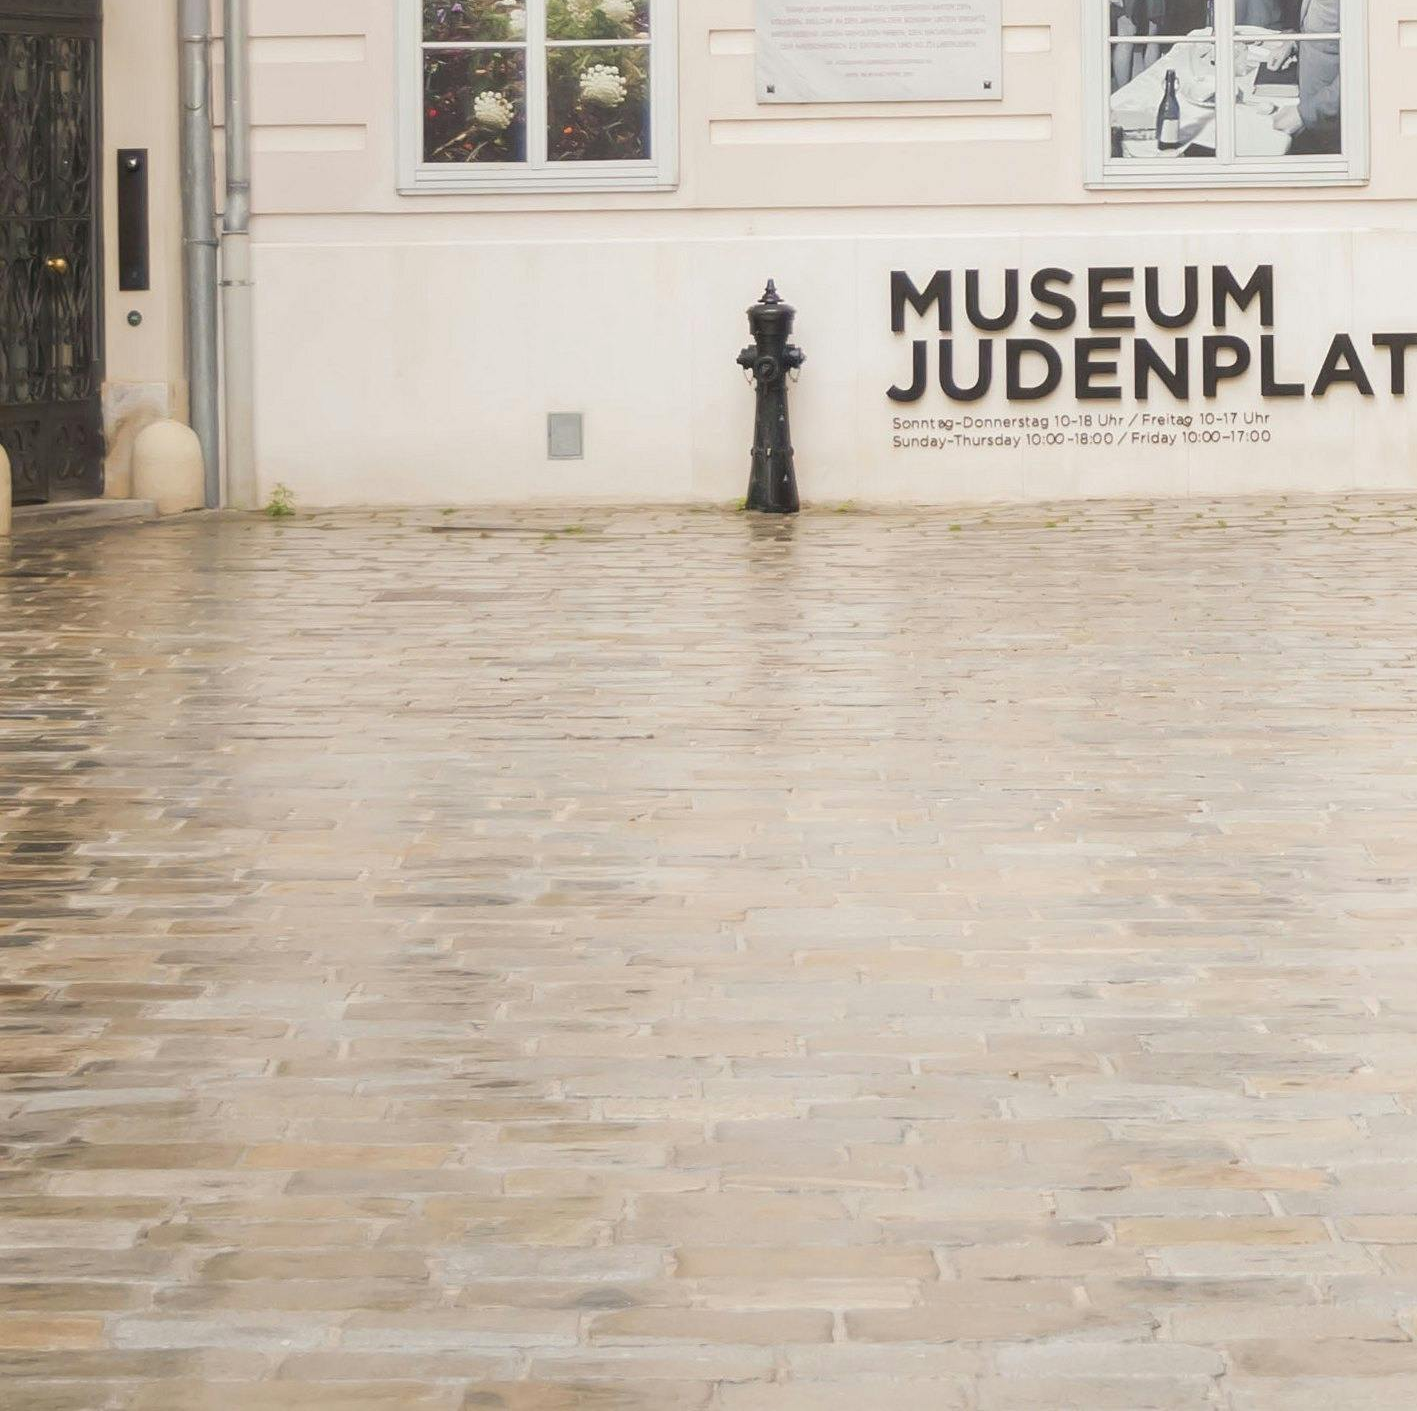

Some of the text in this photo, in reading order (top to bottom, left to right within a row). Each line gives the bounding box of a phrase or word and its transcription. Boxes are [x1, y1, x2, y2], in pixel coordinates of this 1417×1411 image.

[890, 264, 1274, 332] MUSEUM
[892, 411, 1271, 431] Sonntag-Donnerstag 10-18 Uhr / Freitag 10-17 Uhr
[892, 433, 1021, 449] Sunday-Thursday
[1117, 432, 1127, 446] /
[1131, 431, 1178, 447] Friday
[1182, 429, 1272, 444] 10:00-17:00
